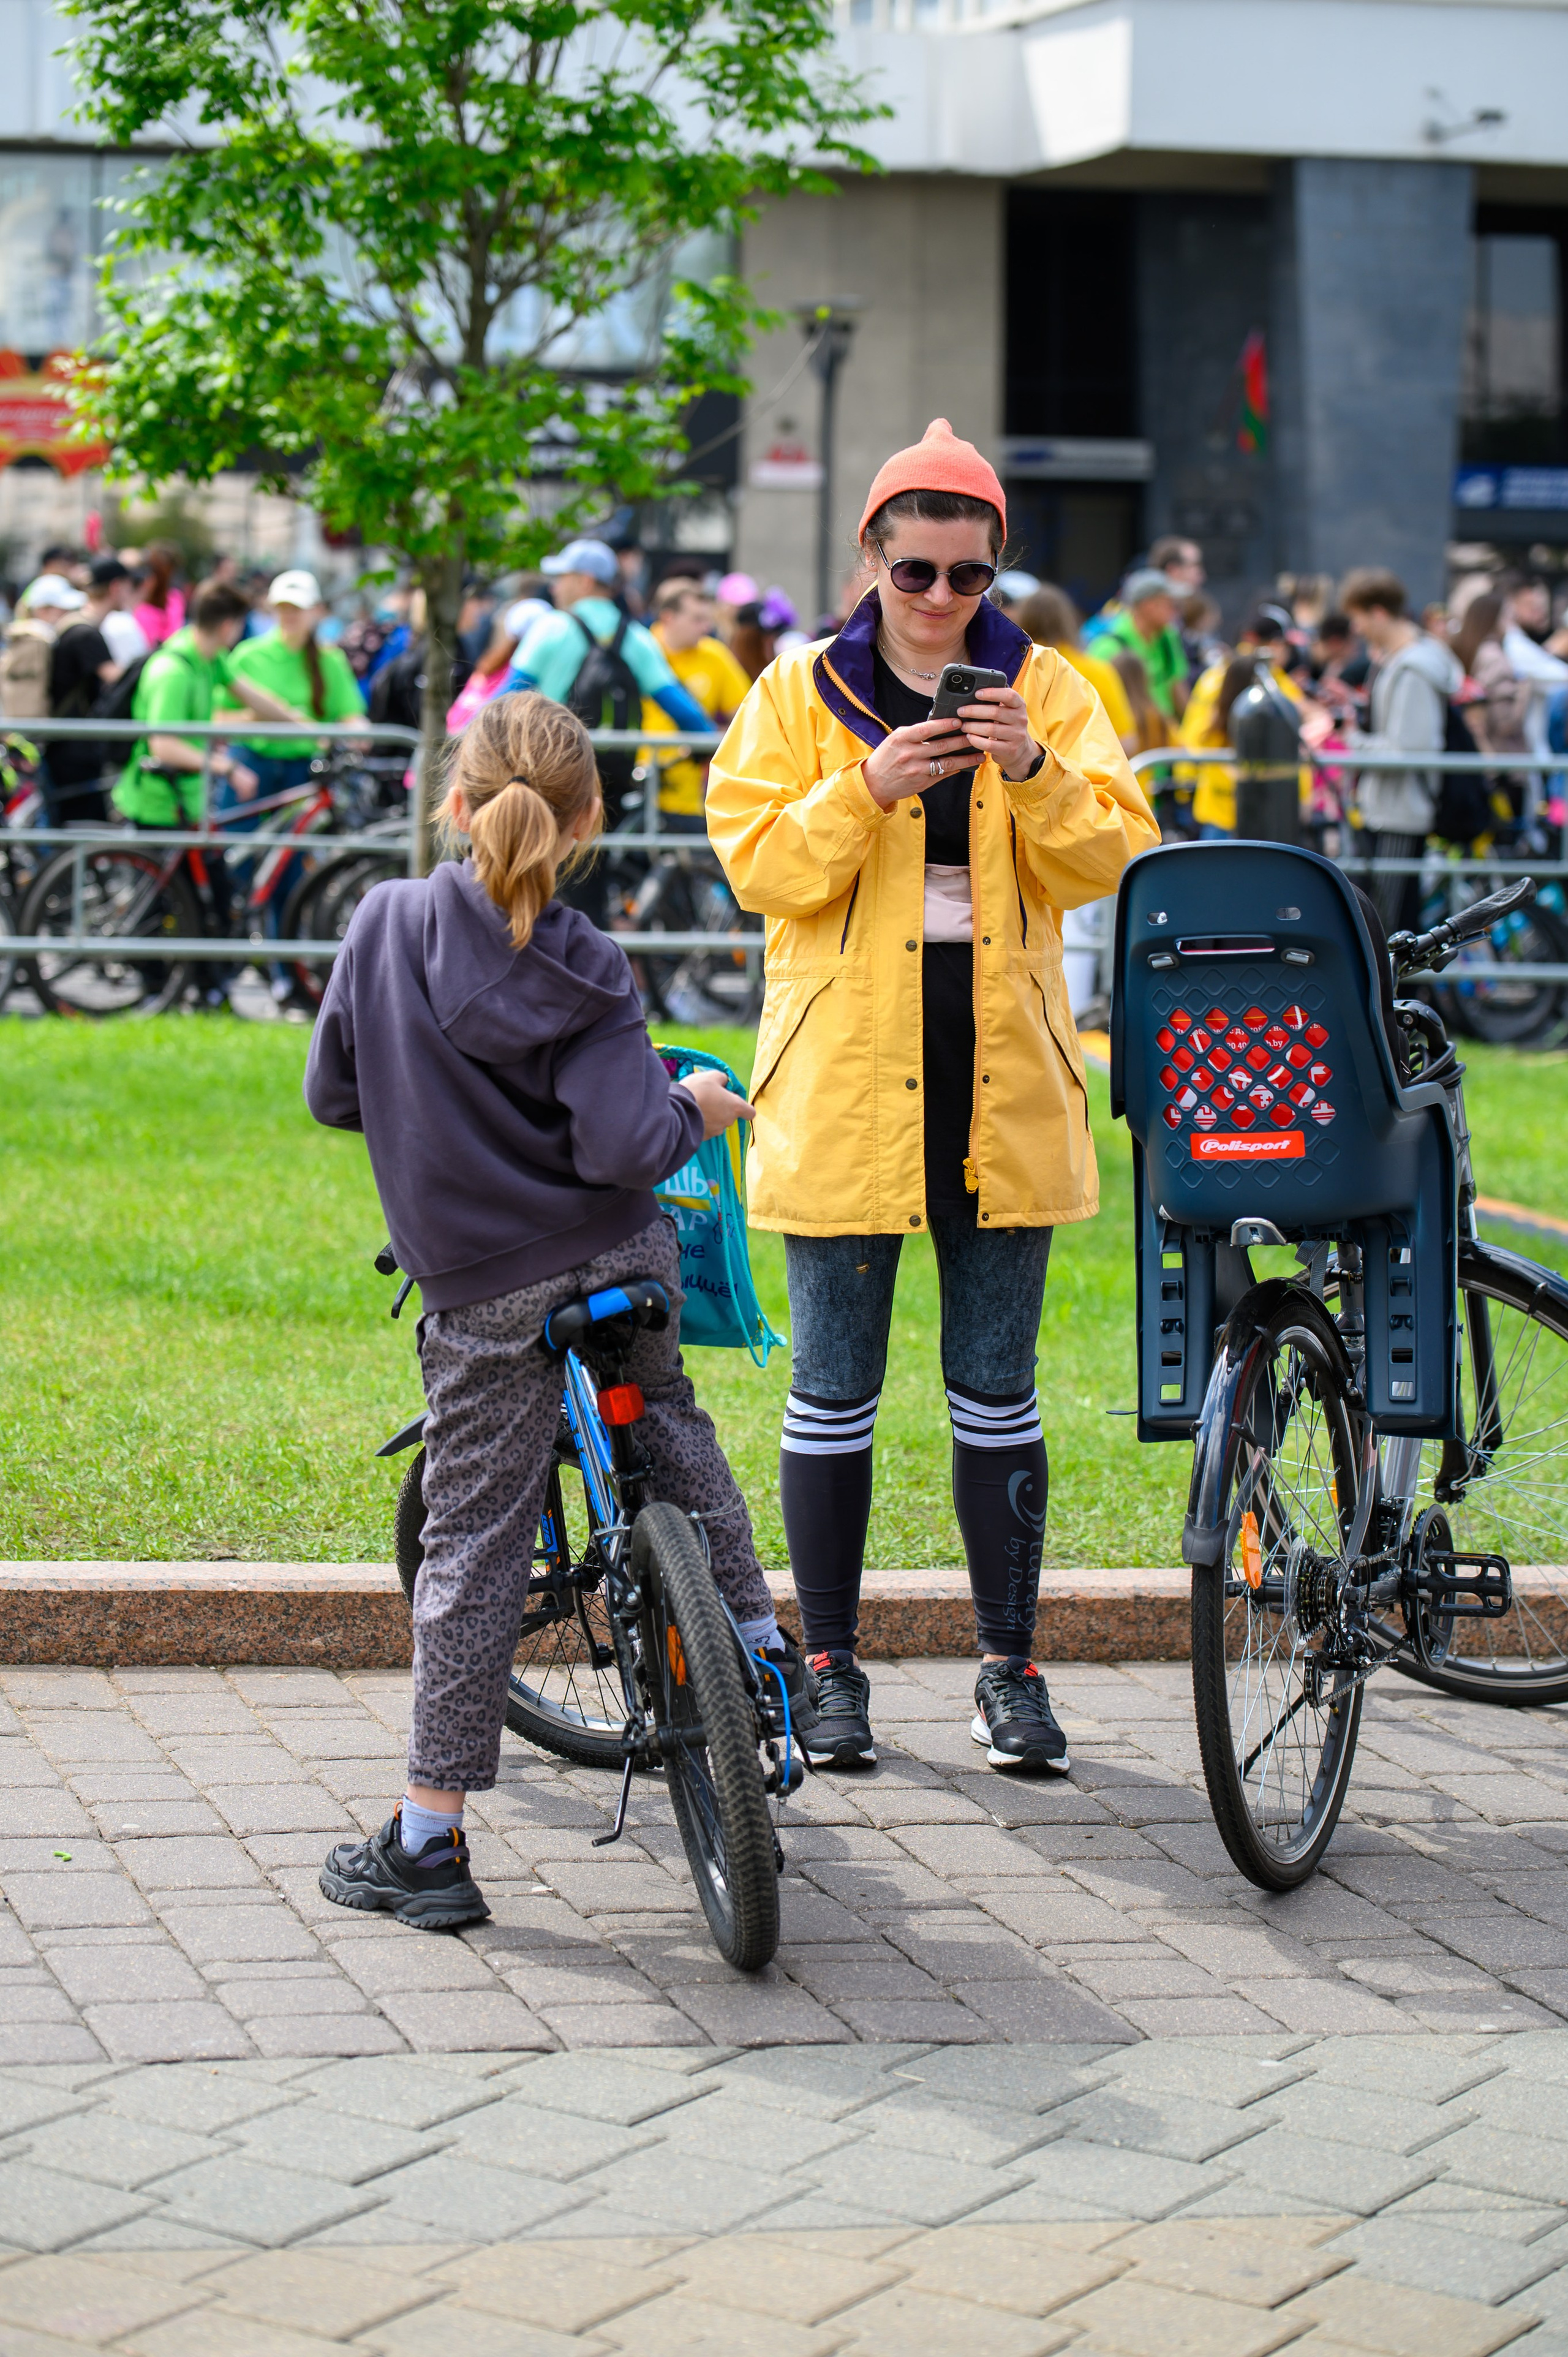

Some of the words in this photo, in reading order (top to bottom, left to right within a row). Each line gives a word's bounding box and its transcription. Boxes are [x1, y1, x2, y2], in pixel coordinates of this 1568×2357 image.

[1200, 1139, 1291, 1153] Polisport
[1005, 1536, 1027, 1561] by
[1003, 1567, 1022, 1630] Design
